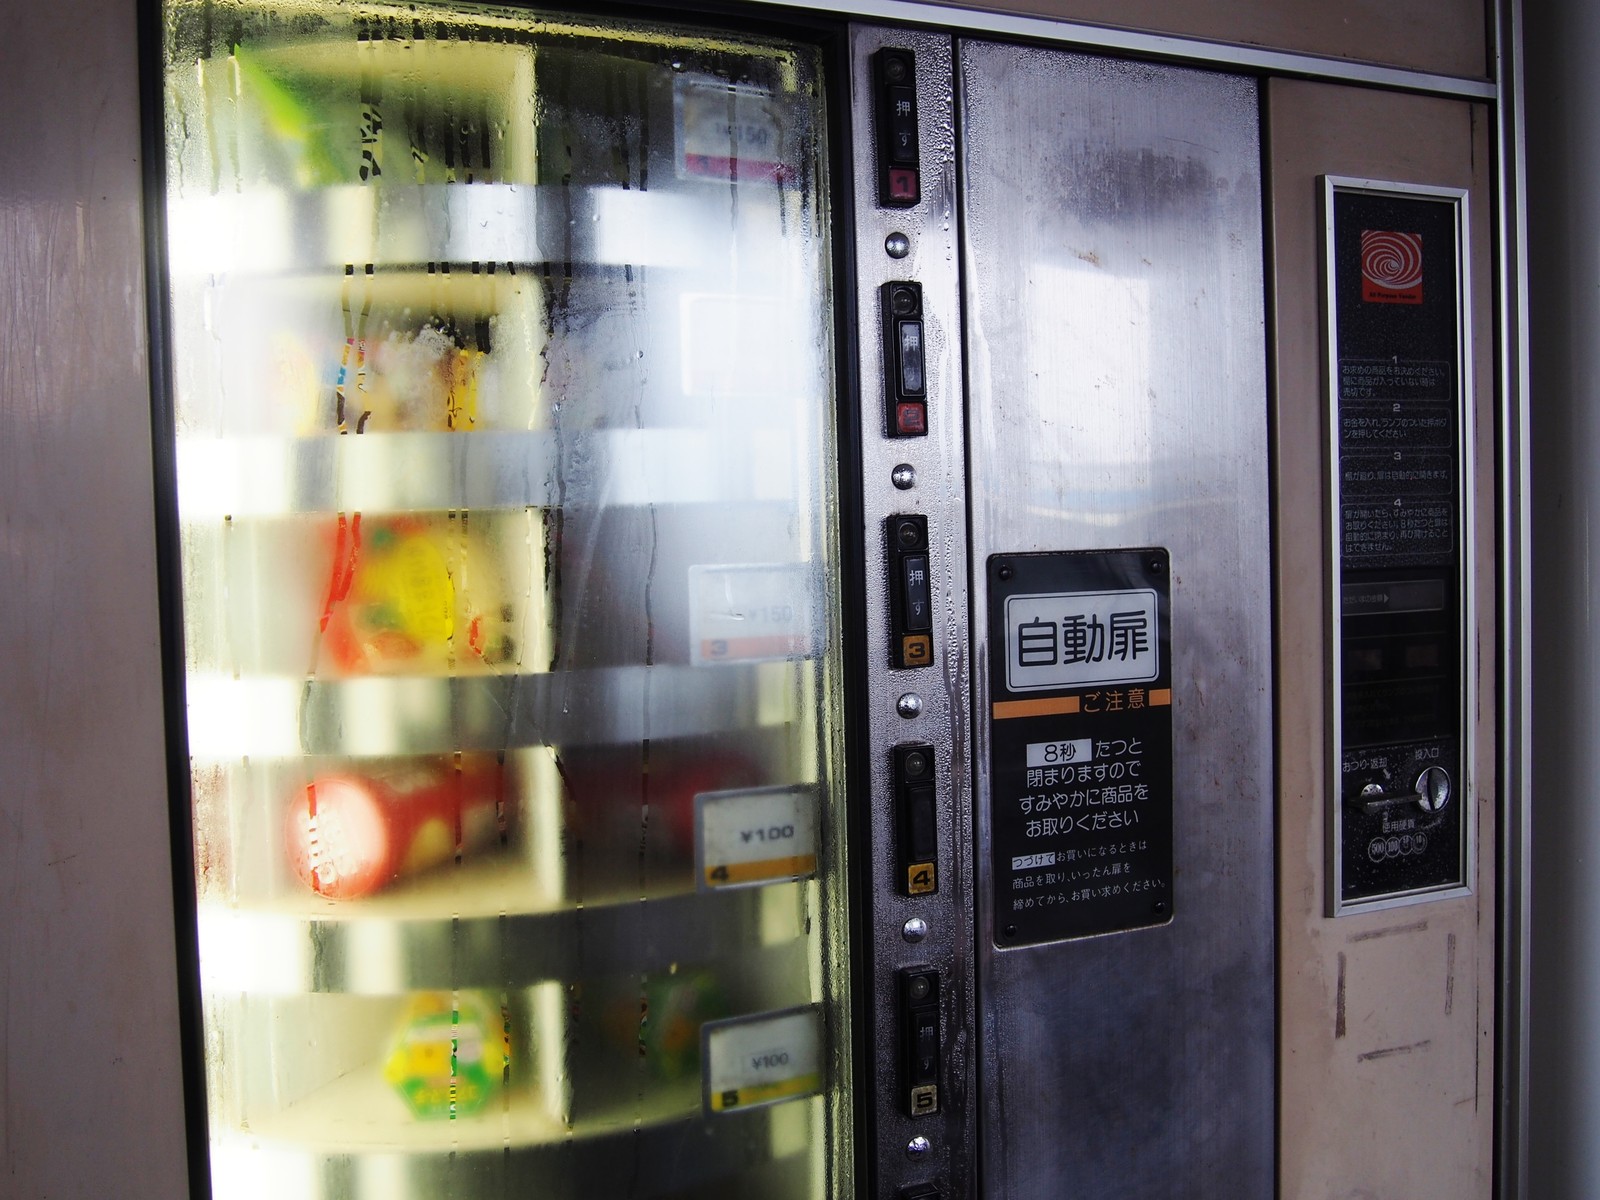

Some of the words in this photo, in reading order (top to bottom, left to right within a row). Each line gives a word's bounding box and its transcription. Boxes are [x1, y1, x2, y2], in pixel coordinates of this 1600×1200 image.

[896, 100, 911, 147] 押す
[896, 175, 909, 193] 1
[1392, 355, 1398, 364] 1
[1392, 403, 1400, 412] 2
[903, 409, 920, 426] 2
[1393, 451, 1401, 460] 3
[1393, 498, 1401, 507] 4
[909, 570, 925, 616] 押す
[711, 639, 728, 656] 3
[1018, 610, 1149, 668] 自動扉
[908, 642, 925, 659] 3
[1083, 688, 1145, 714] ご注意
[1043, 742, 1077, 763] 8秒
[1095, 737, 1143, 758] たつと
[1415, 747, 1439, 760] 投入口
[1026, 760, 1142, 788] 閉まりますので
[1019, 783, 1149, 815] すみやかに商品を
[1026, 810, 1139, 838] お取りください
[741, 825, 795, 844] ¥100
[1013, 853, 1054, 868] つづけて
[1056, 840, 1147, 862] お買いになるときは
[1387, 840, 1398, 852] 100
[710, 865, 729, 880] 4
[912, 870, 931, 885] 4
[1012, 862, 1131, 890] 商品を取り、いったん扉を
[1013, 878, 1166, 911] 締めてから、お買い求めください。
[919, 1026, 934, 1070] 押す
[752, 1052, 789, 1070] ¥100
[916, 1091, 933, 1108] 5
